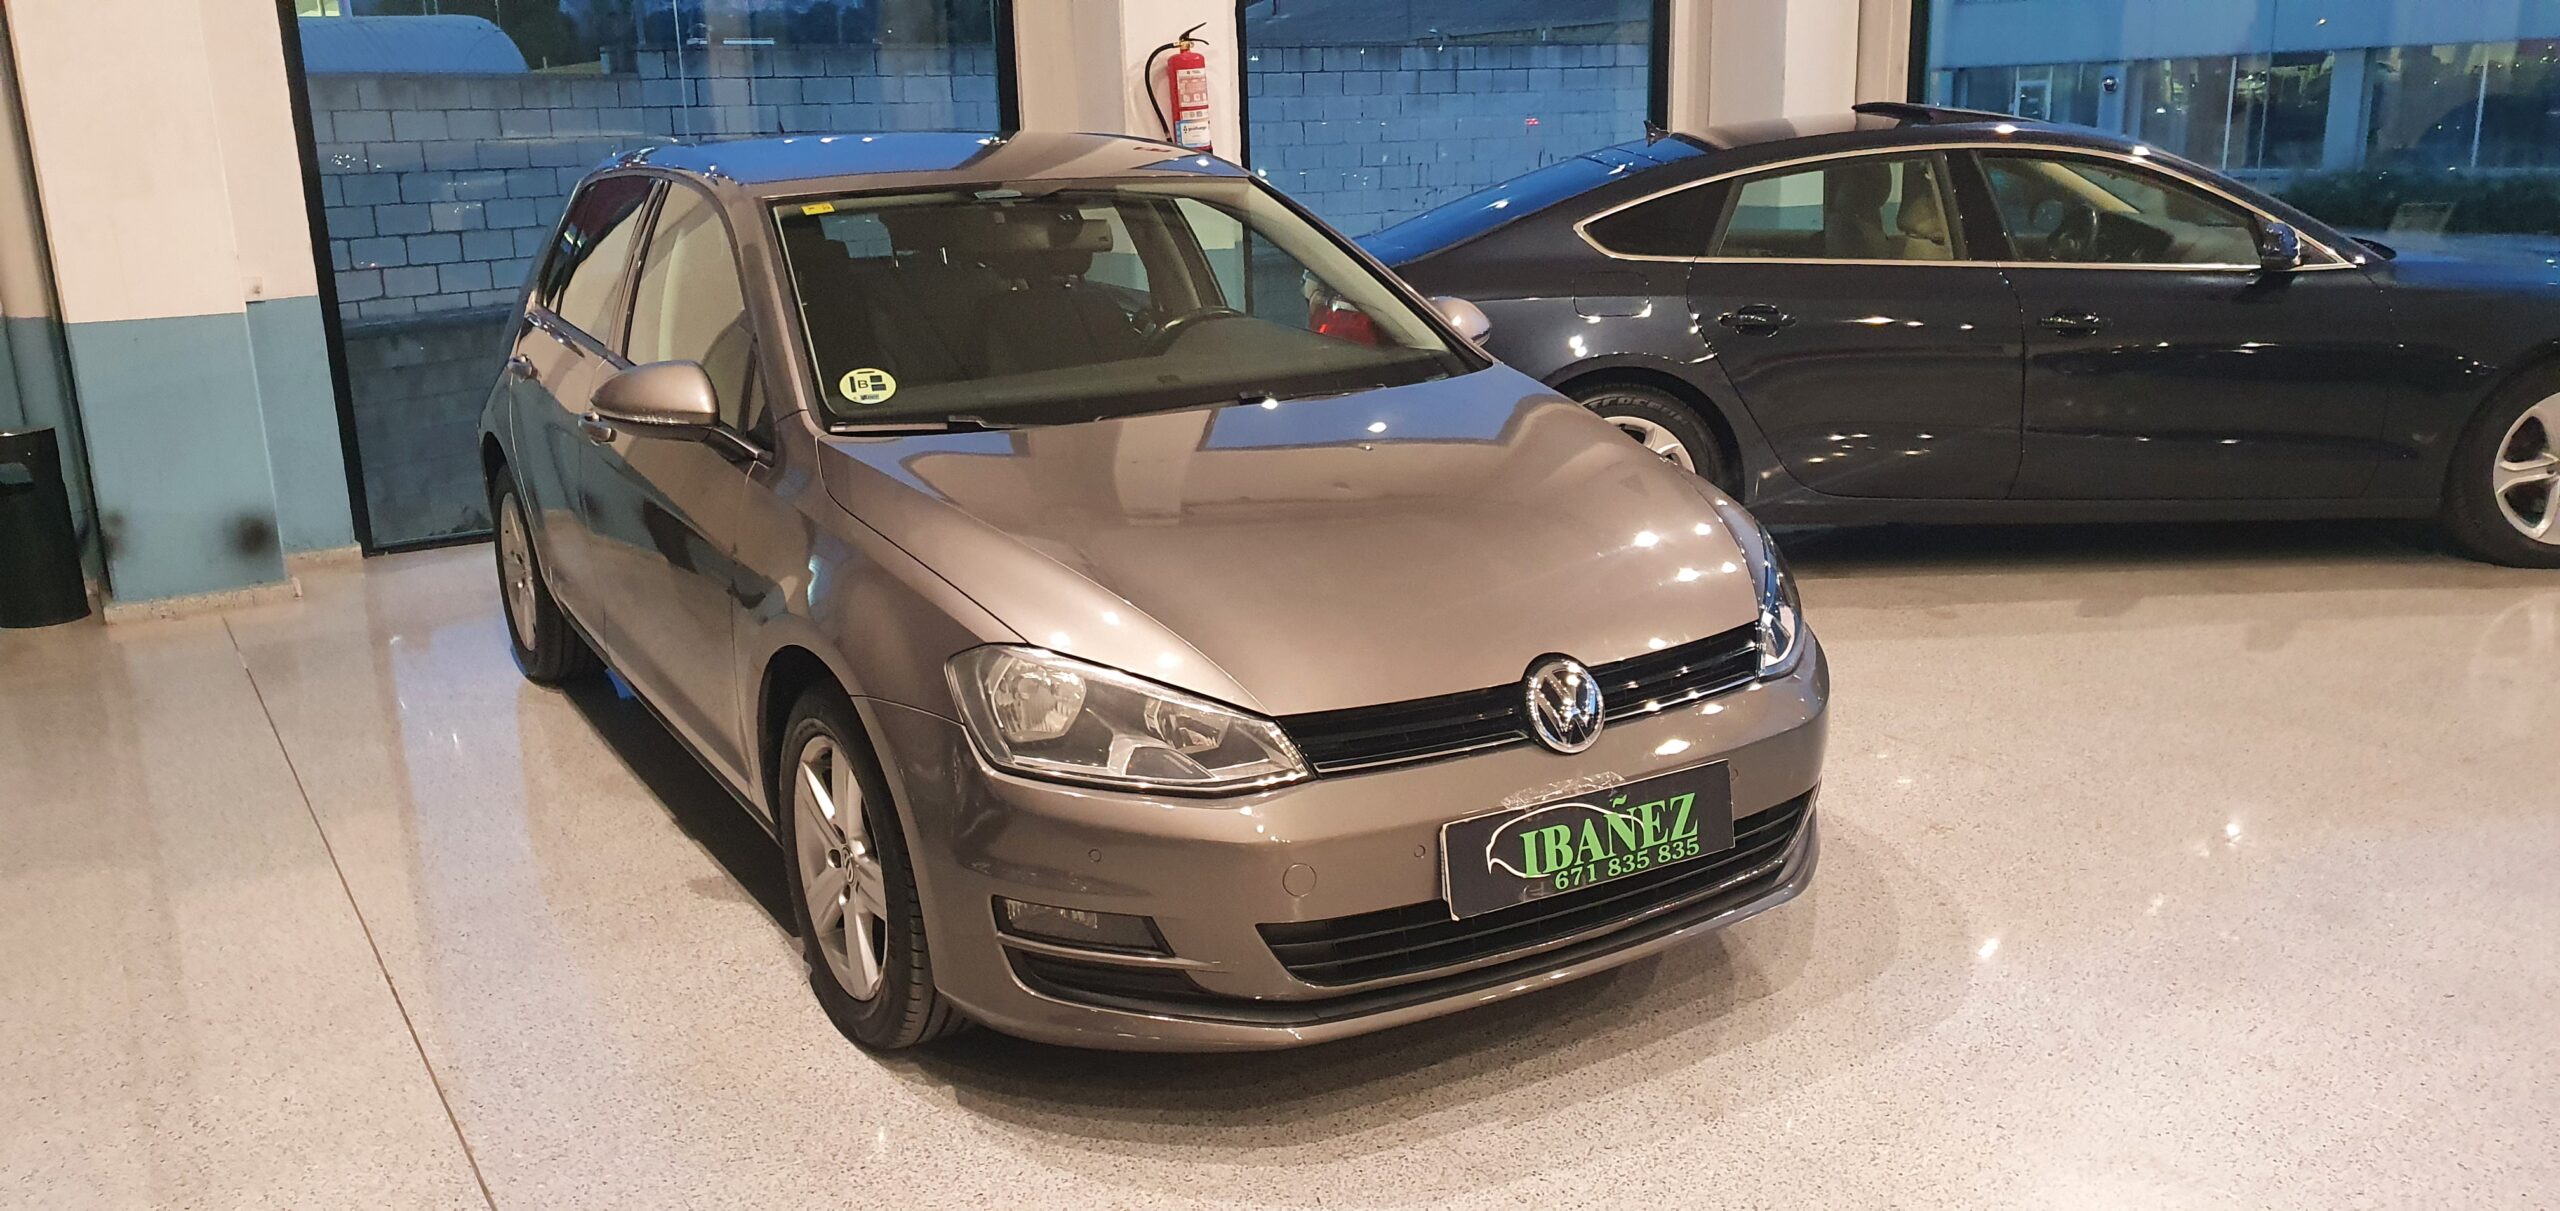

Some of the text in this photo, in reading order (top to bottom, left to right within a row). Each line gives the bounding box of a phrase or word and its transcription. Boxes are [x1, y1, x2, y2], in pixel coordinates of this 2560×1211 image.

[857, 379, 869, 389] B
[1520, 793, 1698, 878] IBAÑEZ
[1555, 836, 1700, 890] 671 835 835
